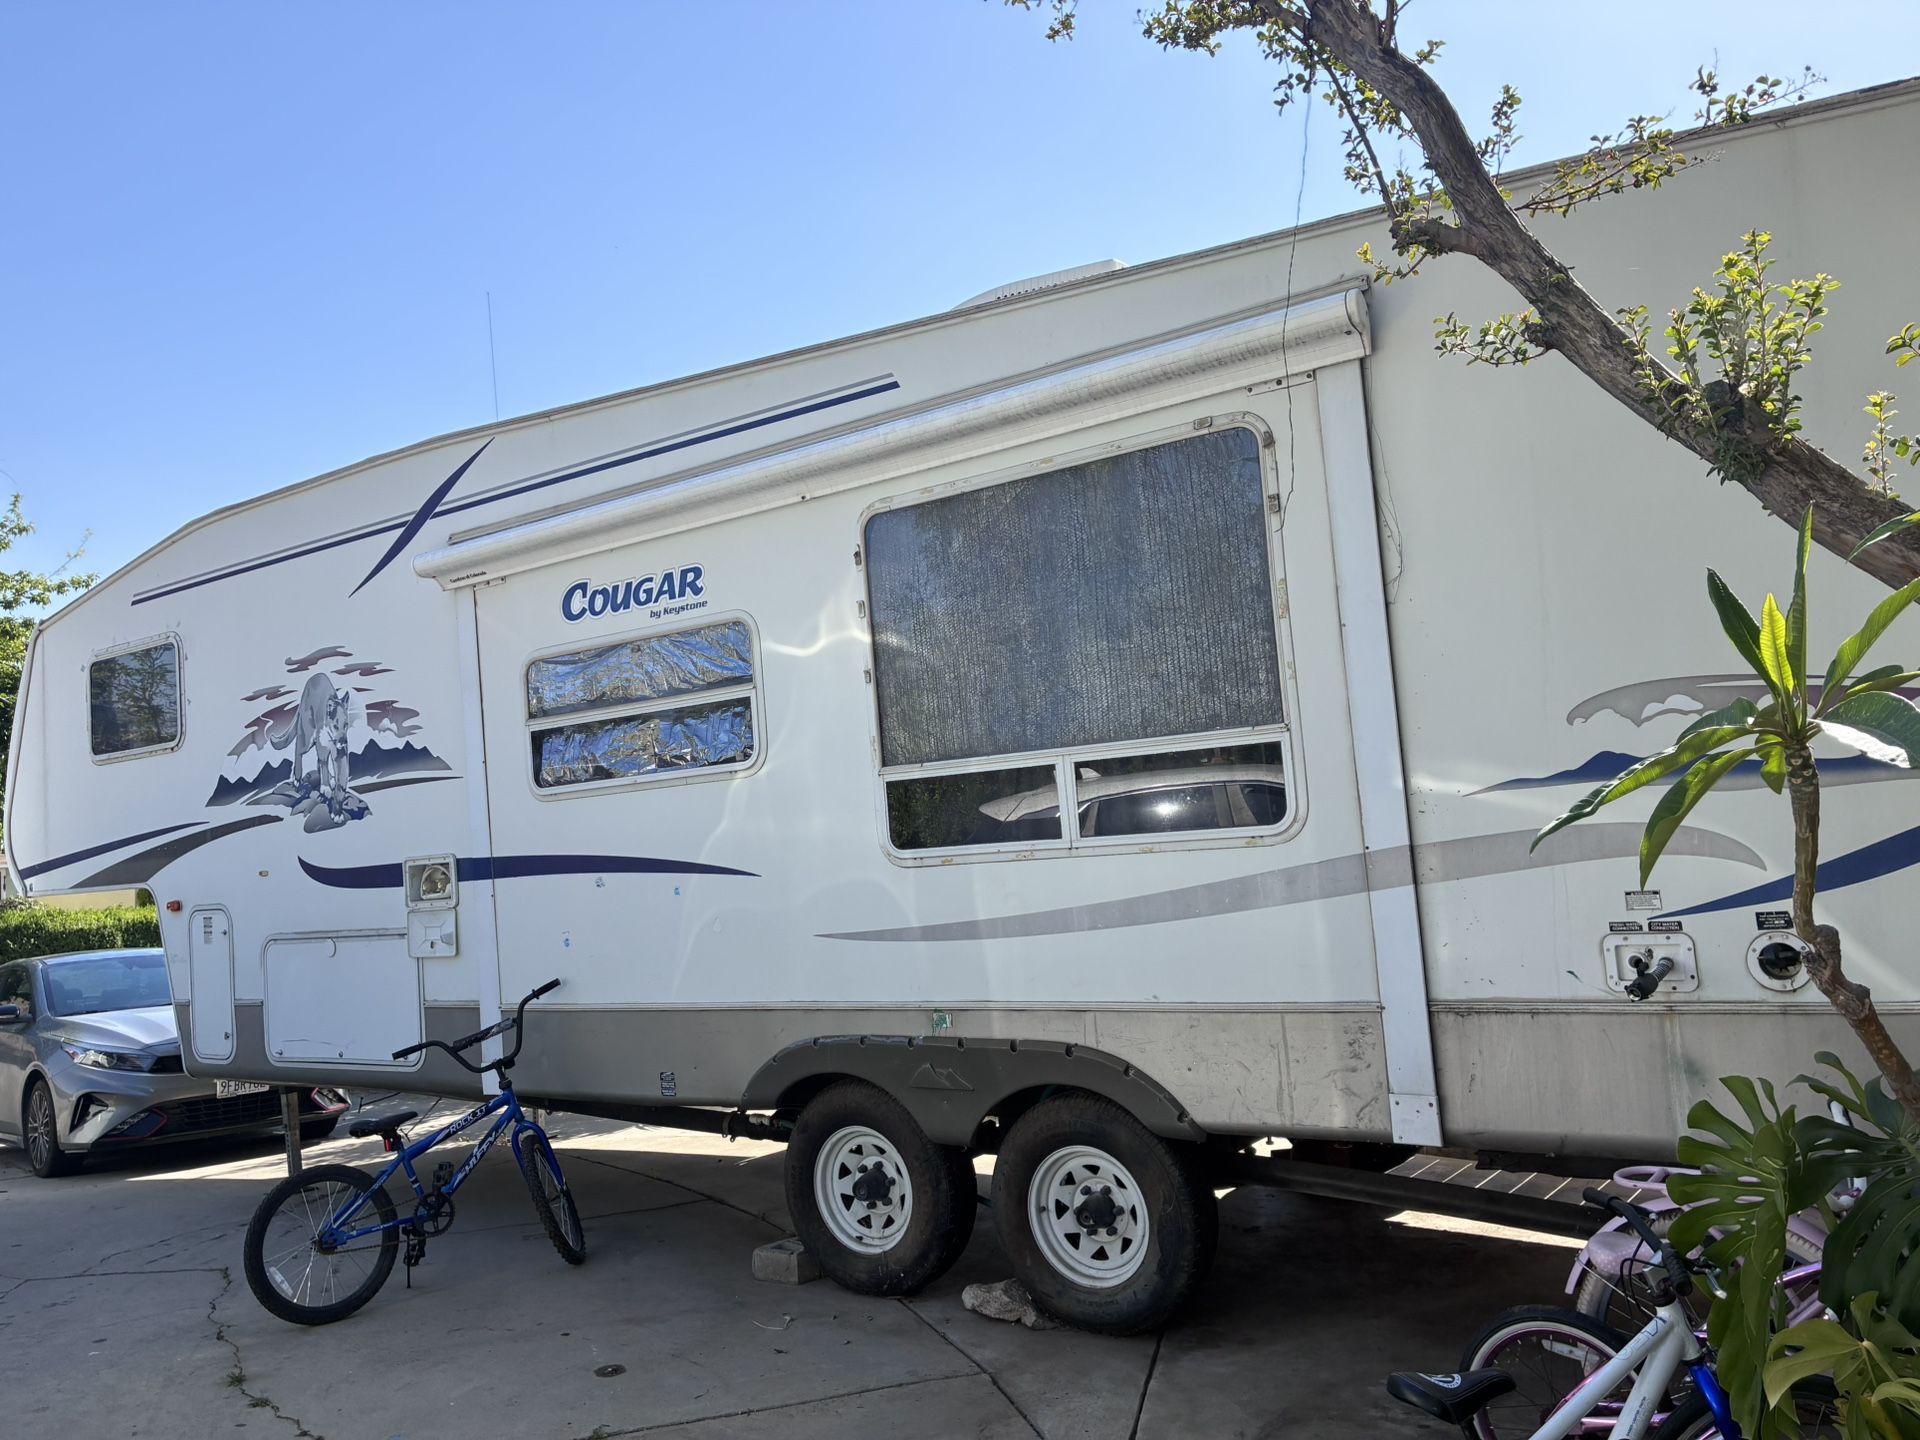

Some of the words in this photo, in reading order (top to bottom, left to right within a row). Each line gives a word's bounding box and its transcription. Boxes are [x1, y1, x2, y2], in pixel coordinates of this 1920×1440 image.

[562, 565, 705, 622] COUGAR
[650, 608, 661, 619] by
[663, 600, 708, 616] Keystone
[449, 1113, 474, 1134] ROCK
[464, 1130, 496, 1174] HUFFY
